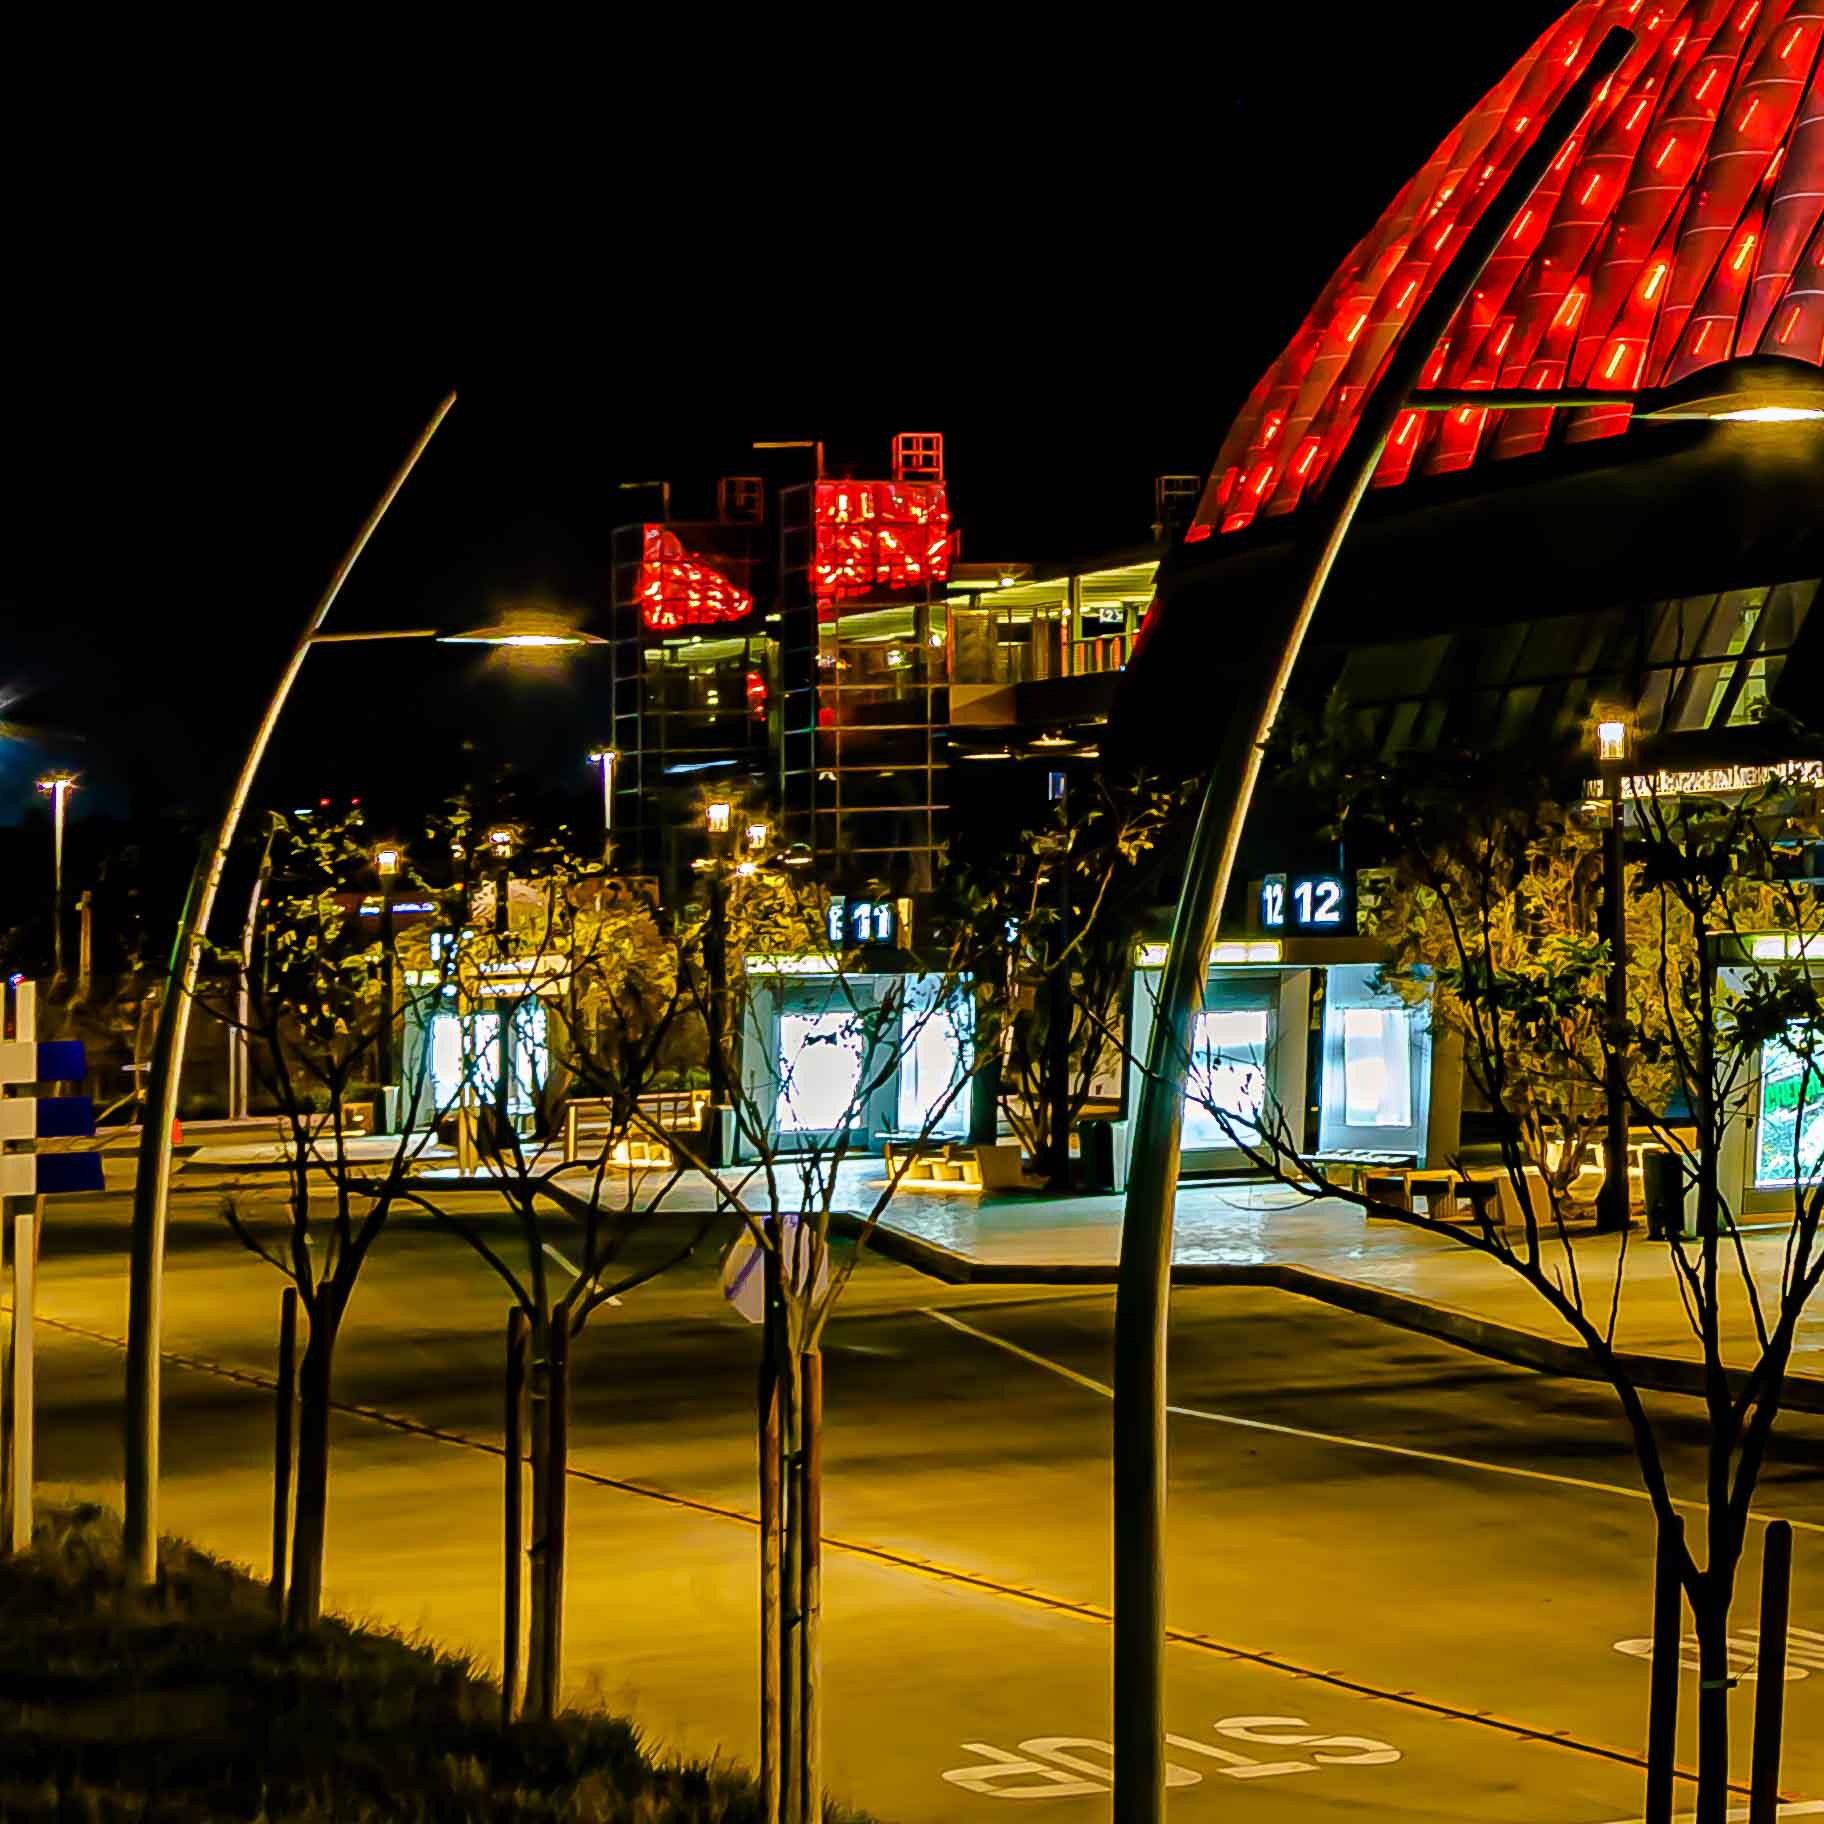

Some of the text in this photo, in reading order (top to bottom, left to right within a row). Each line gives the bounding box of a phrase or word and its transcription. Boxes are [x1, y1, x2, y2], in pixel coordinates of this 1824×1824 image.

[853, 903, 890, 940] 11
[1293, 880, 1342, 923] 12
[941, 1715, 1402, 1799] STOP
